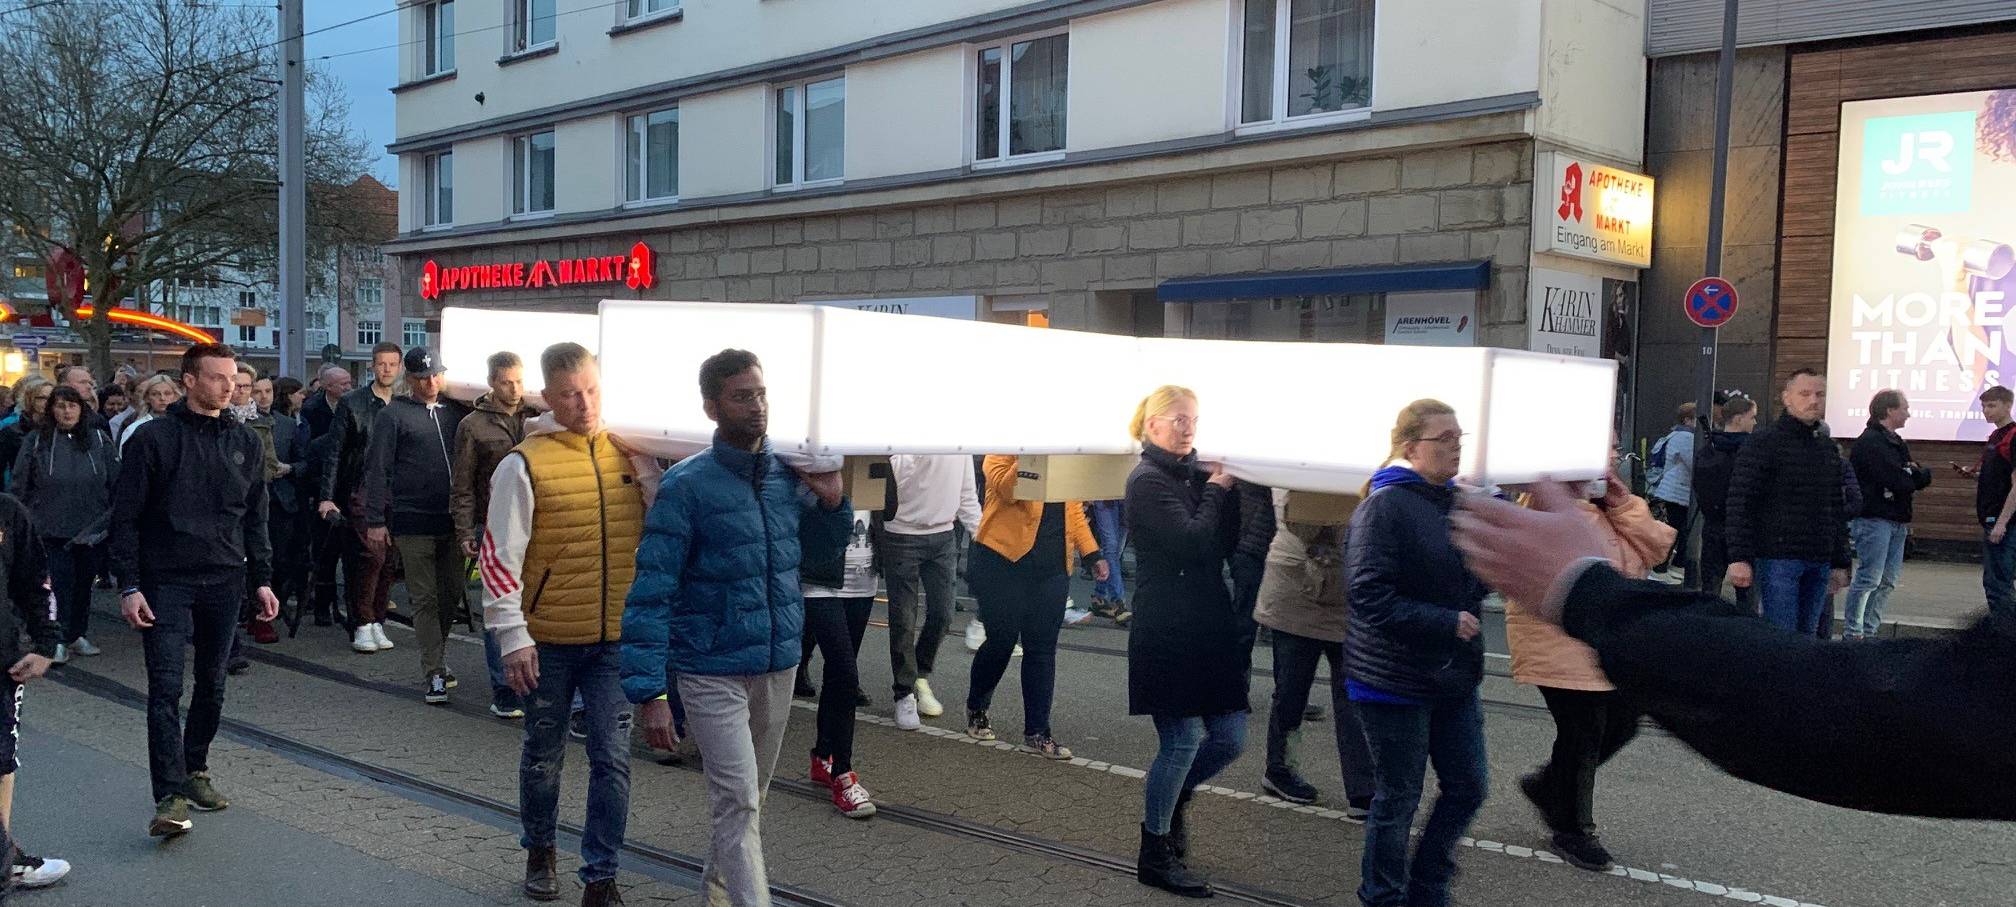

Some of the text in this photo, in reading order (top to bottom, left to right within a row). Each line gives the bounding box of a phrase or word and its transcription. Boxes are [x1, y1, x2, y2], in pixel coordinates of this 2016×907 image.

[1881, 130, 1953, 175] JR
[1589, 170, 1643, 197] APOTHEKE
[1557, 226, 1644, 257] Eingang am Markt
[1596, 214, 1631, 236] MARKT
[441, 263, 524, 290] APOTHEKE
[560, 256, 625, 284] MARKT
[1538, 287, 1595, 332] KARIN
[1852, 291, 2004, 328] MORE
[1852, 331, 2001, 366] THAN
[1849, 368, 2000, 392] FITNESS
